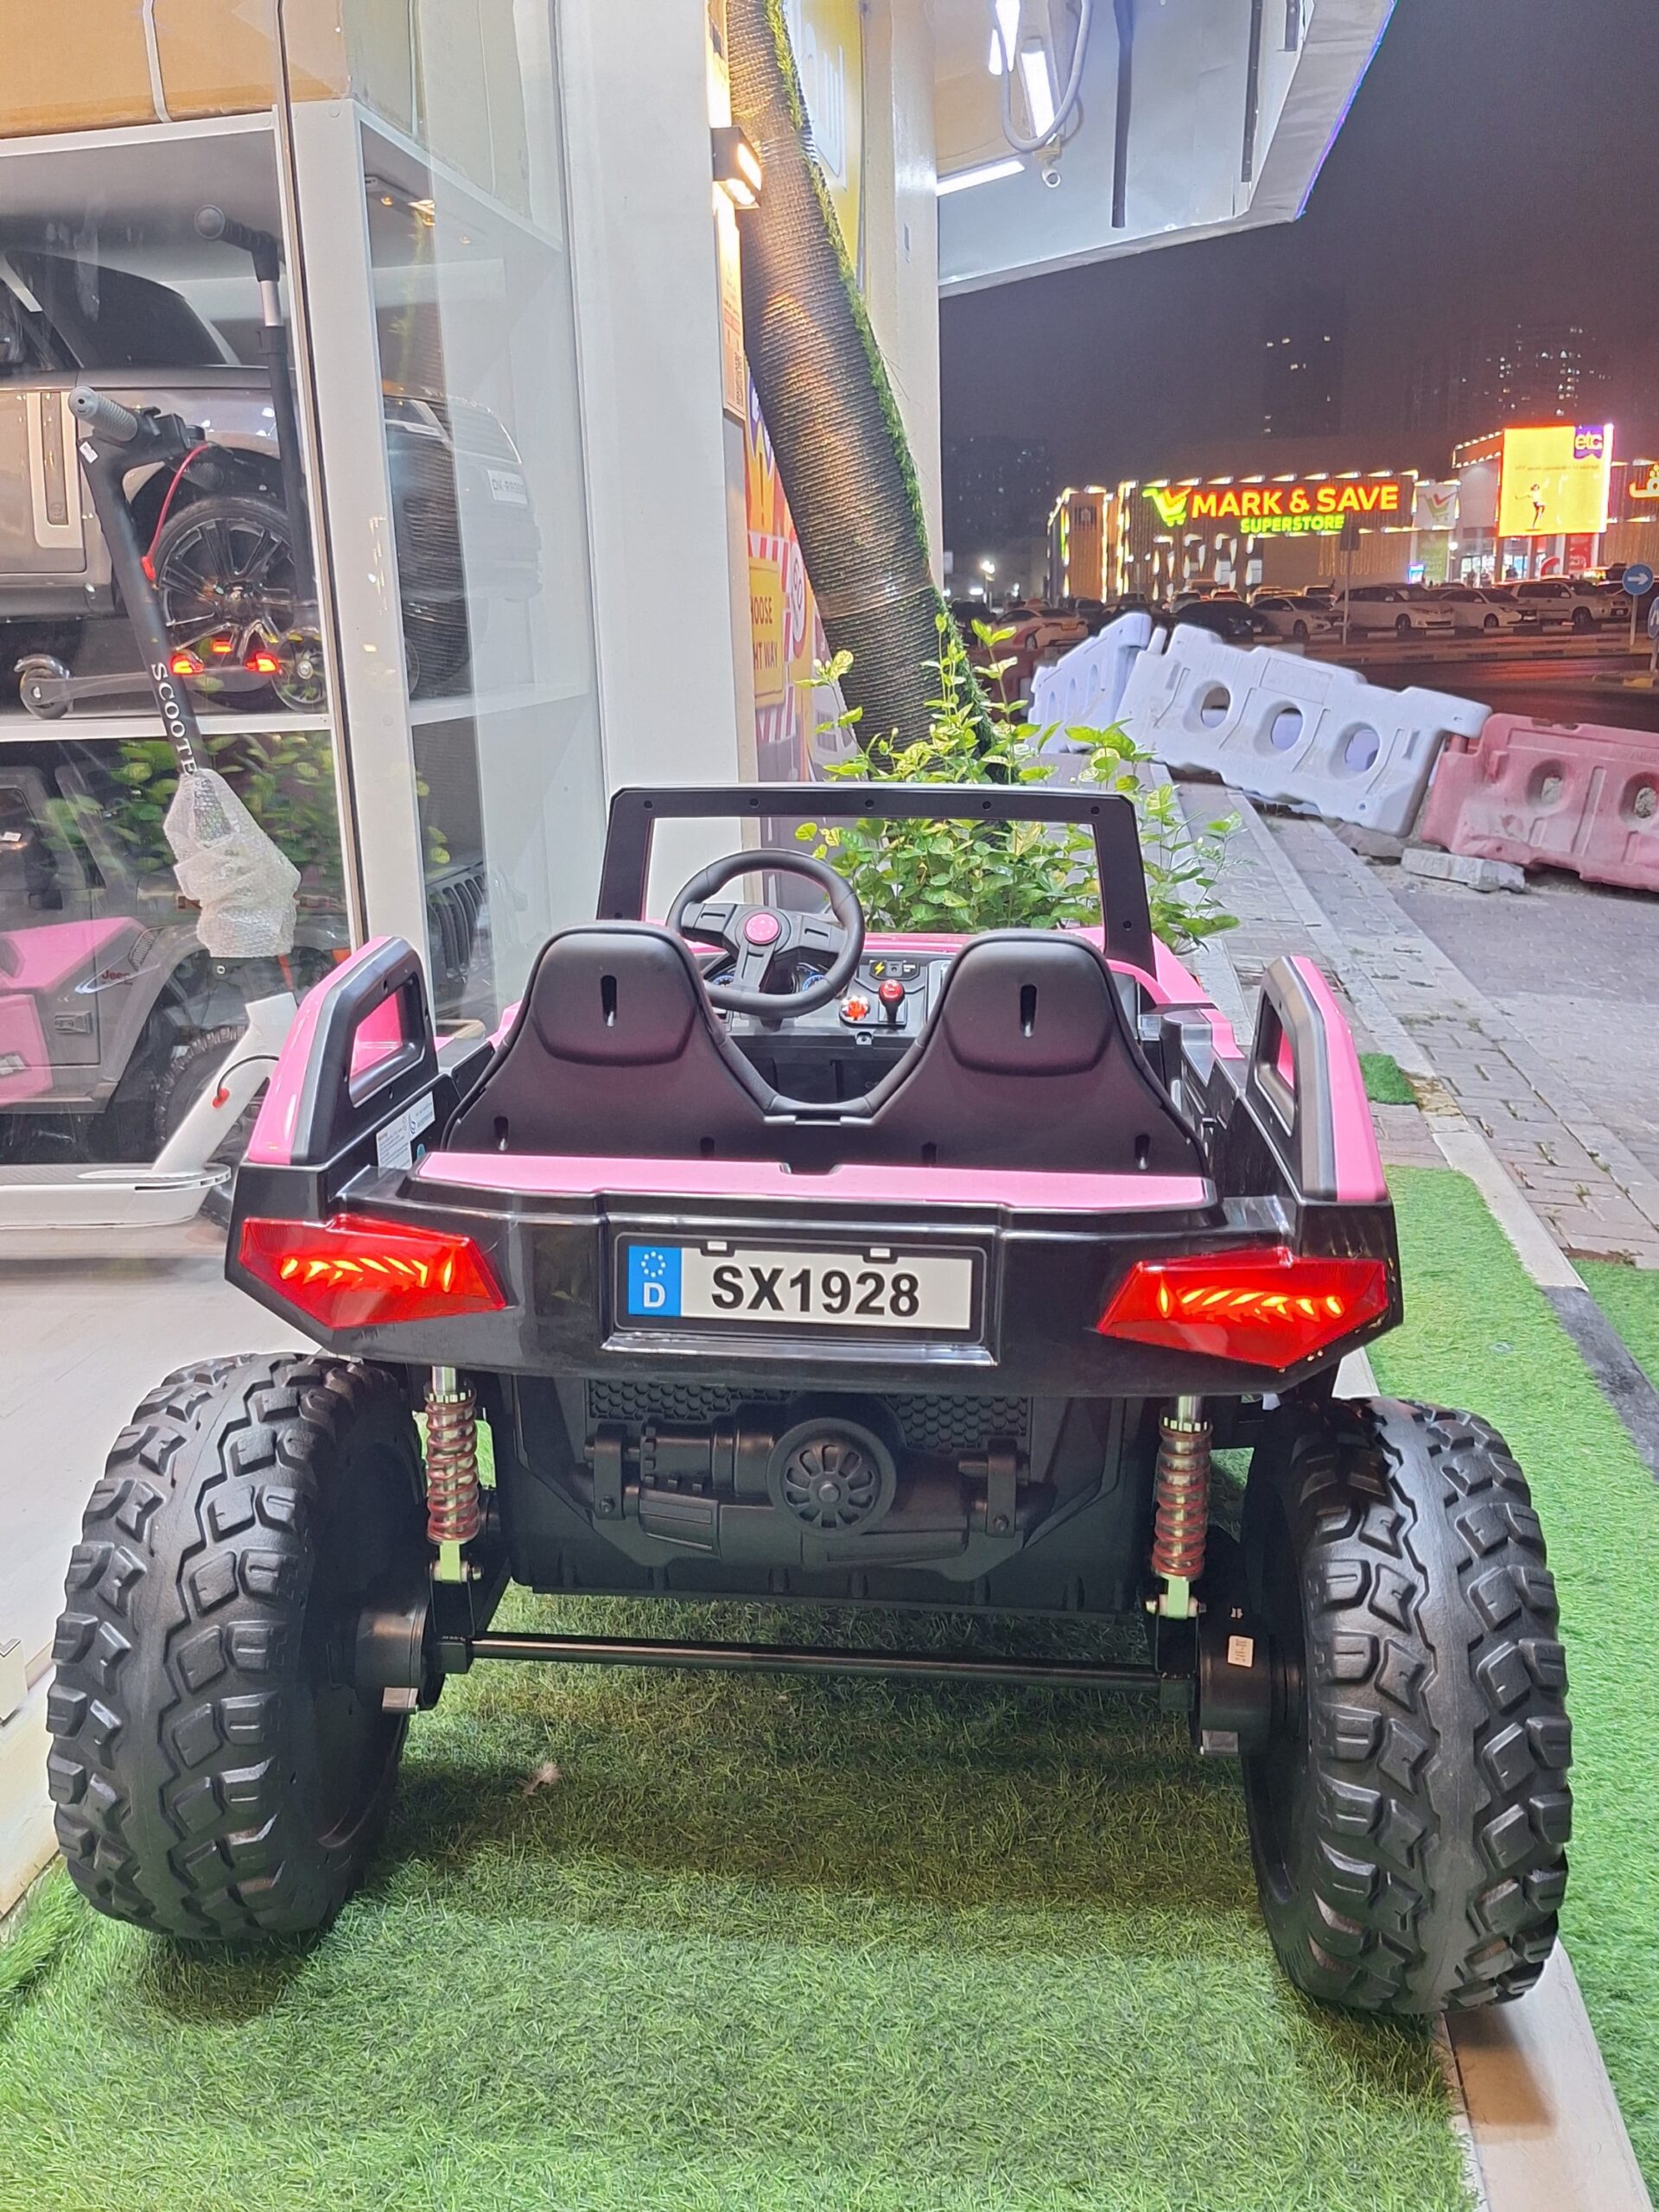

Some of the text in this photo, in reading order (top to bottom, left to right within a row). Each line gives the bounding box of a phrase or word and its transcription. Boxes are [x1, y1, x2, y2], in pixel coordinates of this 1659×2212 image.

[1574, 431, 1603, 450] etc
[1192, 482, 1399, 518] MARK & SAVE
[1240, 513, 1345, 533] SUPERSTORE
[643, 1264, 920, 1318] D SX1928
